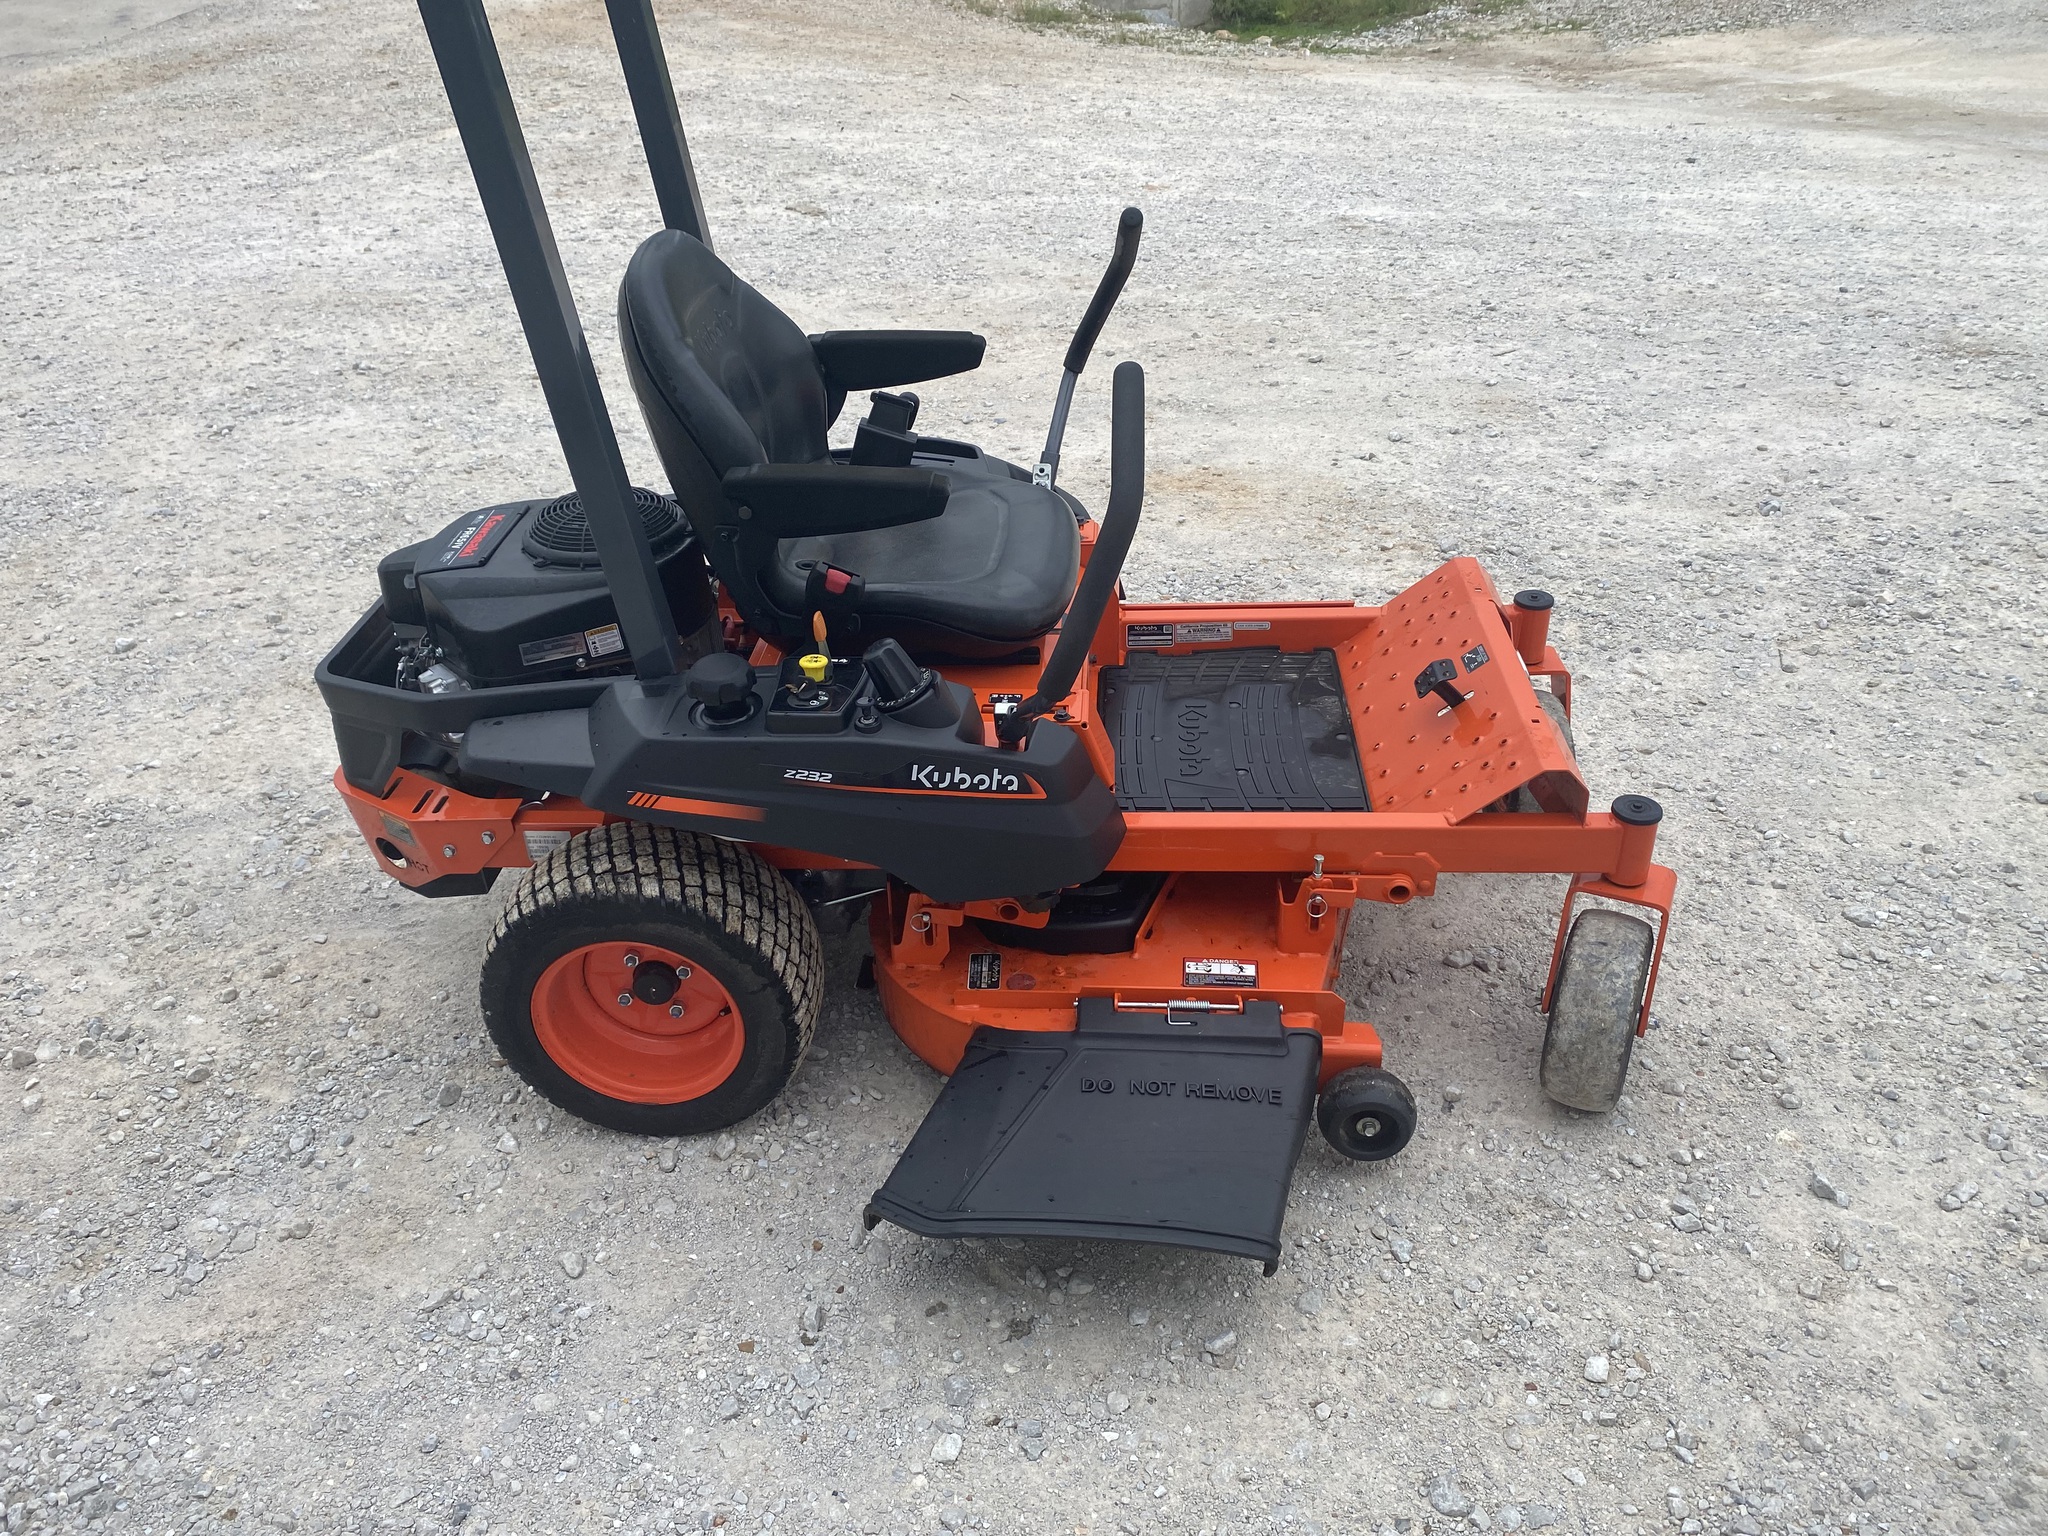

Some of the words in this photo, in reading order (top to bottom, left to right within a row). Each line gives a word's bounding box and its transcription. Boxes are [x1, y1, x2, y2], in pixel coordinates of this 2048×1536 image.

[458, 514, 506, 557] Kawasaki
[1177, 703, 1210, 777] Kubota
[783, 769, 833, 783] Z232
[911, 764, 1019, 791] Kubota
[1081, 1077, 1116, 1093] DO
[1129, 1079, 1177, 1097] NOT
[1184, 1082, 1283, 1106] REMOVE
